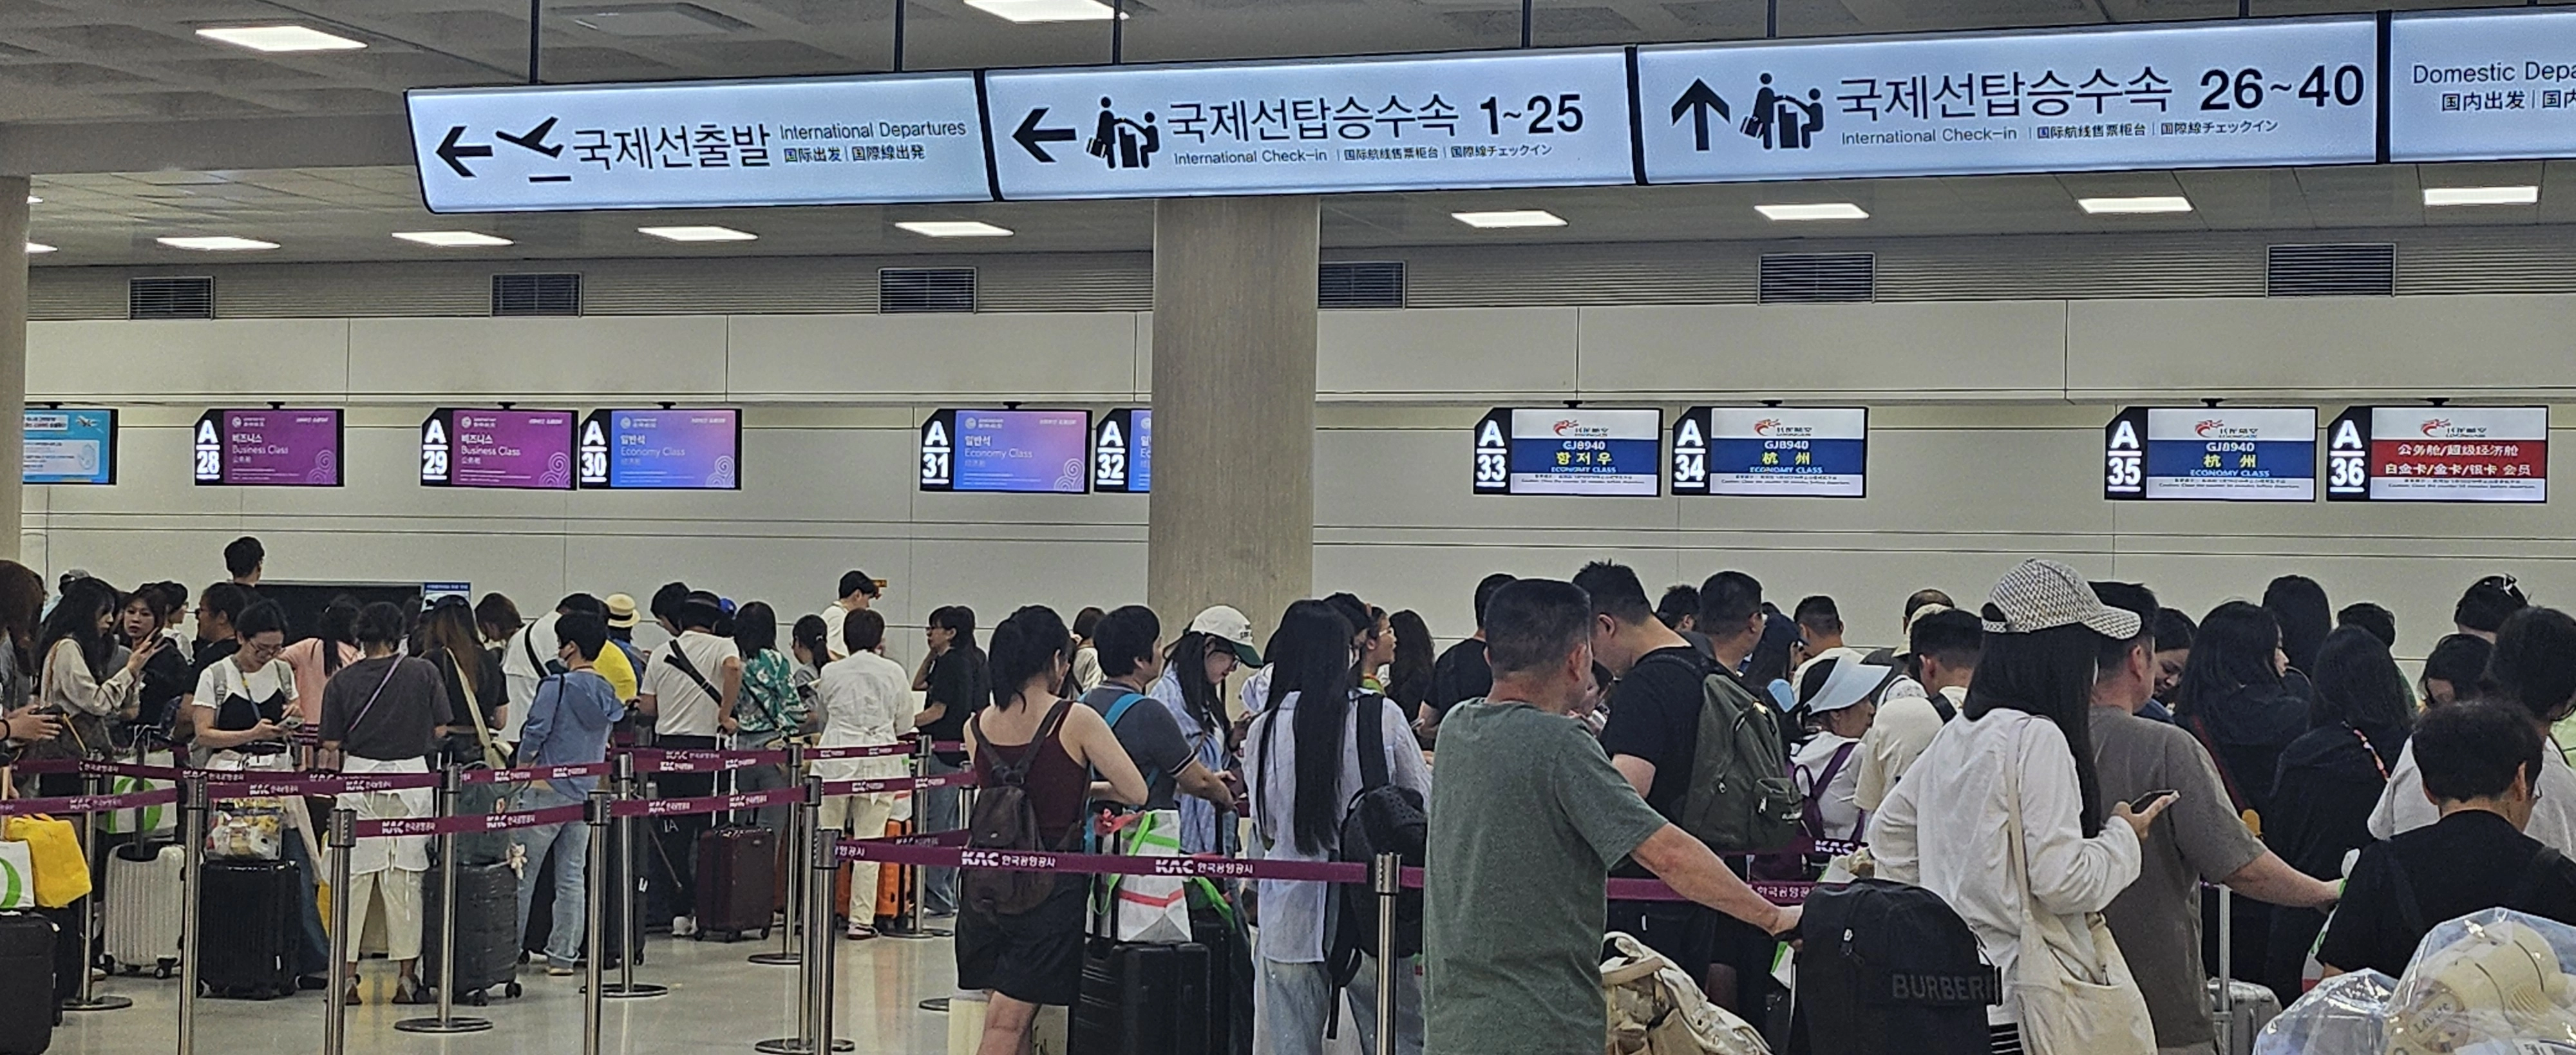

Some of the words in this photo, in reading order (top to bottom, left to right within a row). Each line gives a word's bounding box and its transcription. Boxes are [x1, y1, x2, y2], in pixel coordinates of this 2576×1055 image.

[2413, 62, 2515, 84] Domestic
[1836, 66, 2173, 122] 국제선탑승수속
[2200, 64, 2365, 112] 26~40
[2441, 91, 2525, 111] 国内出发
[1167, 93, 1459, 142] 국제선탑승수속
[1480, 94, 1584, 135] 1~25
[780, 122, 874, 140] International
[879, 121, 967, 139] Departures
[1842, 129, 1936, 145] International
[1942, 127, 2017, 141] Check-in
[573, 124, 771, 170] 국제선출발
[784, 147, 841, 163] 国际出发
[851, 145, 925, 162] 国際線出発
[1174, 151, 1258, 166] International
[1262, 149, 1328, 163] Check-in
[197, 419, 218, 444] A
[424, 419, 447, 443] A
[461, 434, 493, 444] 비즈니스
[583, 420, 605, 445] A
[925, 421, 949, 447] A
[1100, 421, 1124, 446] A
[1479, 420, 1504, 446] A
[1677, 419, 1704, 446] A
[2110, 421, 2139, 449] A
[2333, 419, 2363, 449] A
[232, 445, 266, 454] Business
[267, 444, 289, 454] Class
[461, 446, 496, 455] Business
[498, 446, 520, 456] Class
[621, 447, 661, 459] Economy
[663, 447, 685, 457] Class
[964, 448, 1007, 460] Economy
[1009, 448, 1033, 458] Class
[196, 451, 220, 473] 28
[422, 451, 448, 475] 29
[582, 452, 607, 476] 30
[922, 453, 949, 478] 31
[1097, 453, 1124, 479] 32
[1477, 454, 1506, 481] 33
[1674, 454, 1705, 481] 34
[2107, 457, 2141, 485] 35
[2240, 469, 2269, 477] CLASS
[2329, 457, 2365, 486] 36
[961, 851, 999, 867] KAC
[1001, 855, 1056, 868] 한국공항공사
[1155, 859, 1194, 875] KAC
[1197, 861, 1254, 875] 한국공항공사
